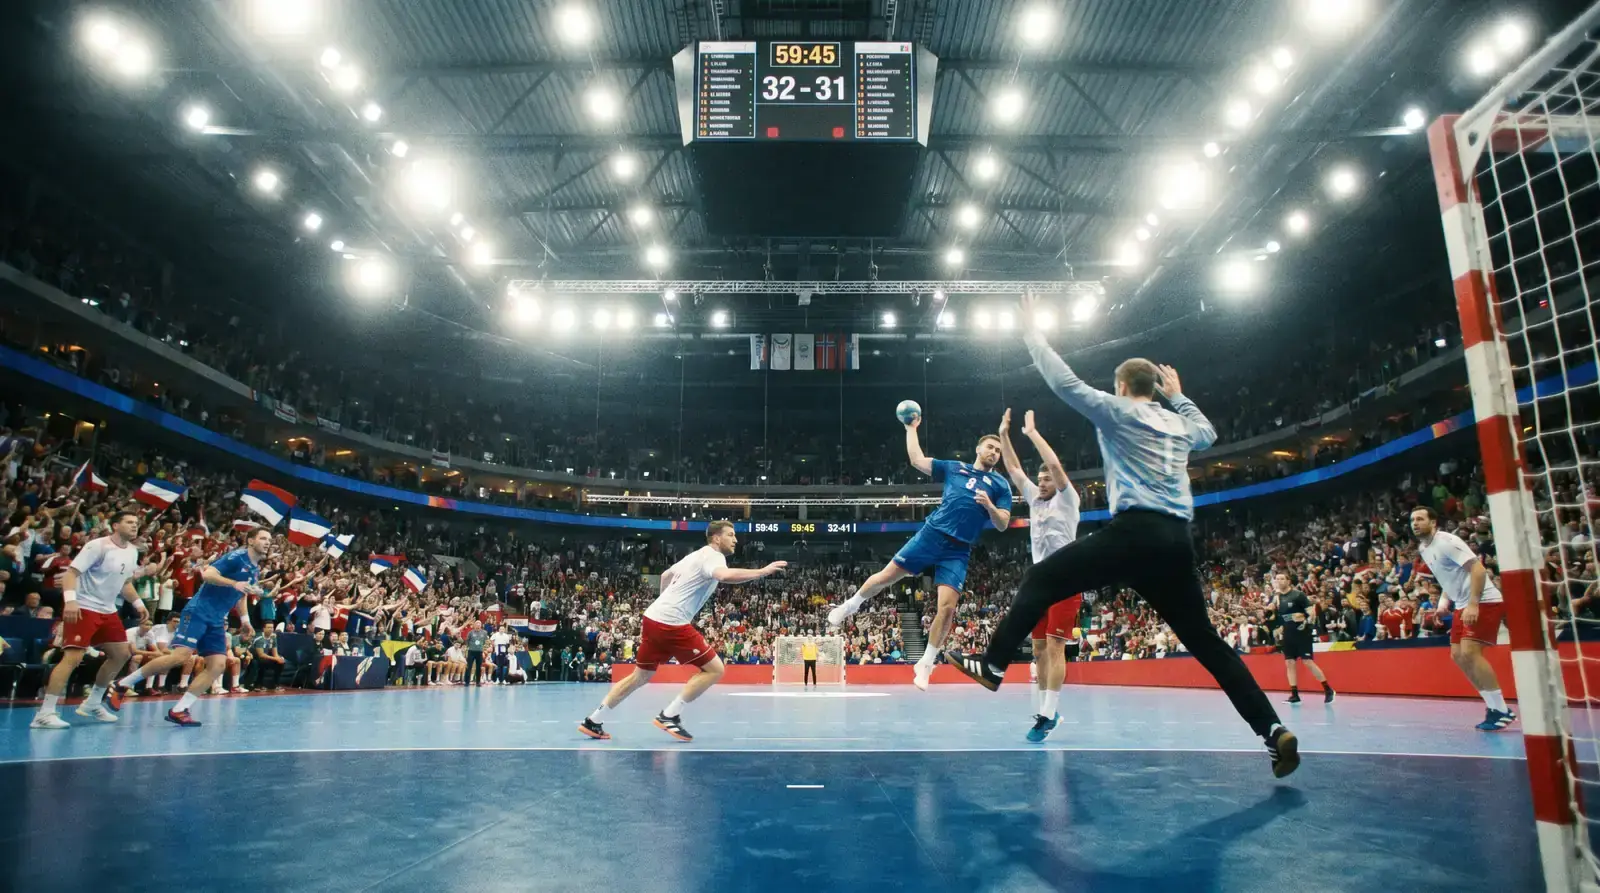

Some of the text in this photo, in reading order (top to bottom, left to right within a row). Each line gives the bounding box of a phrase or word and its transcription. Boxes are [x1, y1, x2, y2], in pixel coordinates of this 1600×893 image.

[776, 45, 835, 64] 59:45
[762, 76, 796, 100] 32
[815, 76, 845, 100] 31
[755, 523, 779, 532] 59:45
[791, 523, 815, 532] 59:45
[827, 523, 851, 532] 32-41
